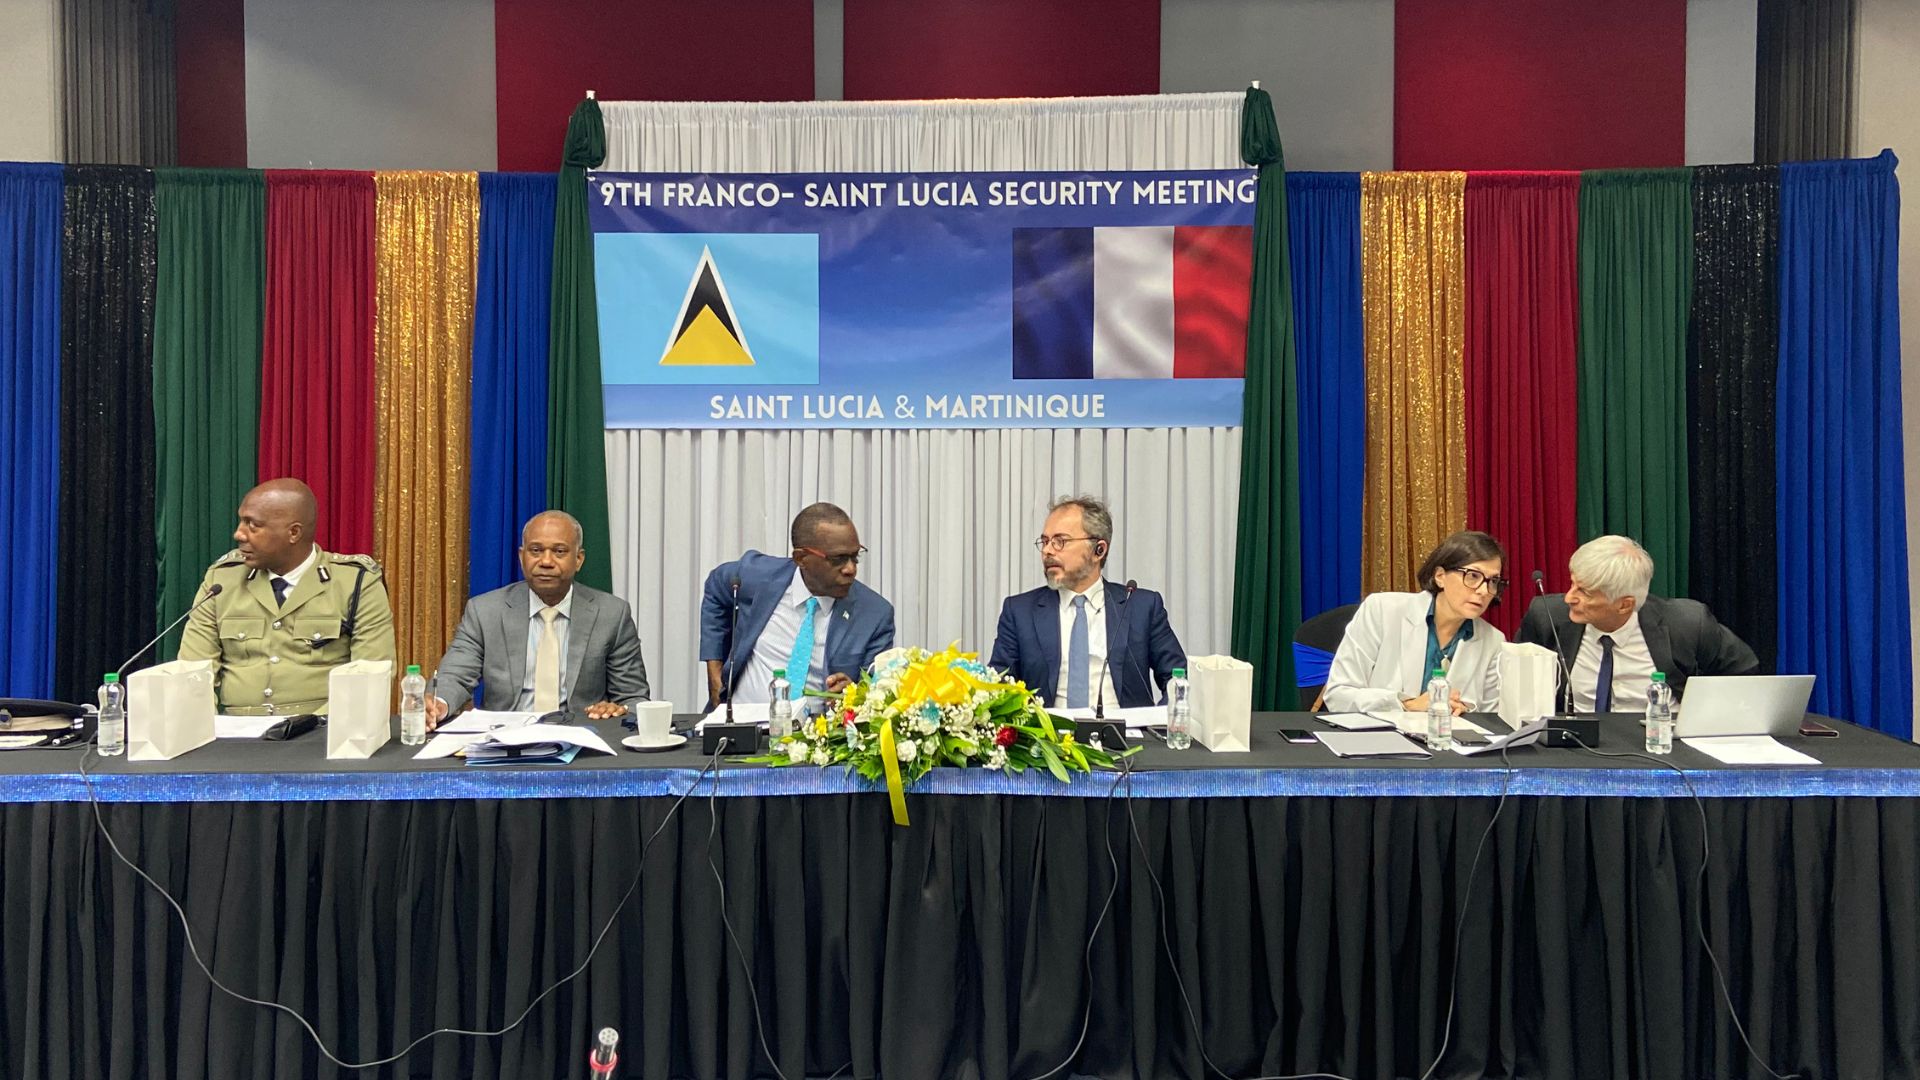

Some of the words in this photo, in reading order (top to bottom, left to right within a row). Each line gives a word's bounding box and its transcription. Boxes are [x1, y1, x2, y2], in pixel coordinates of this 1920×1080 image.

[600, 181, 651, 207] 9TH
[663, 181, 795, 208] FRANCO-
[804, 181, 887, 208] SAINT
[897, 181, 979, 207] LUCIA
[988, 180, 1123, 206] SECURITY
[1133, 179, 1256, 205] MEETING
[710, 394, 793, 420] SAINT
[803, 394, 885, 419] LUCIA
[894, 394, 916, 419] &
[925, 393, 1106, 419] MARTINIQUE
